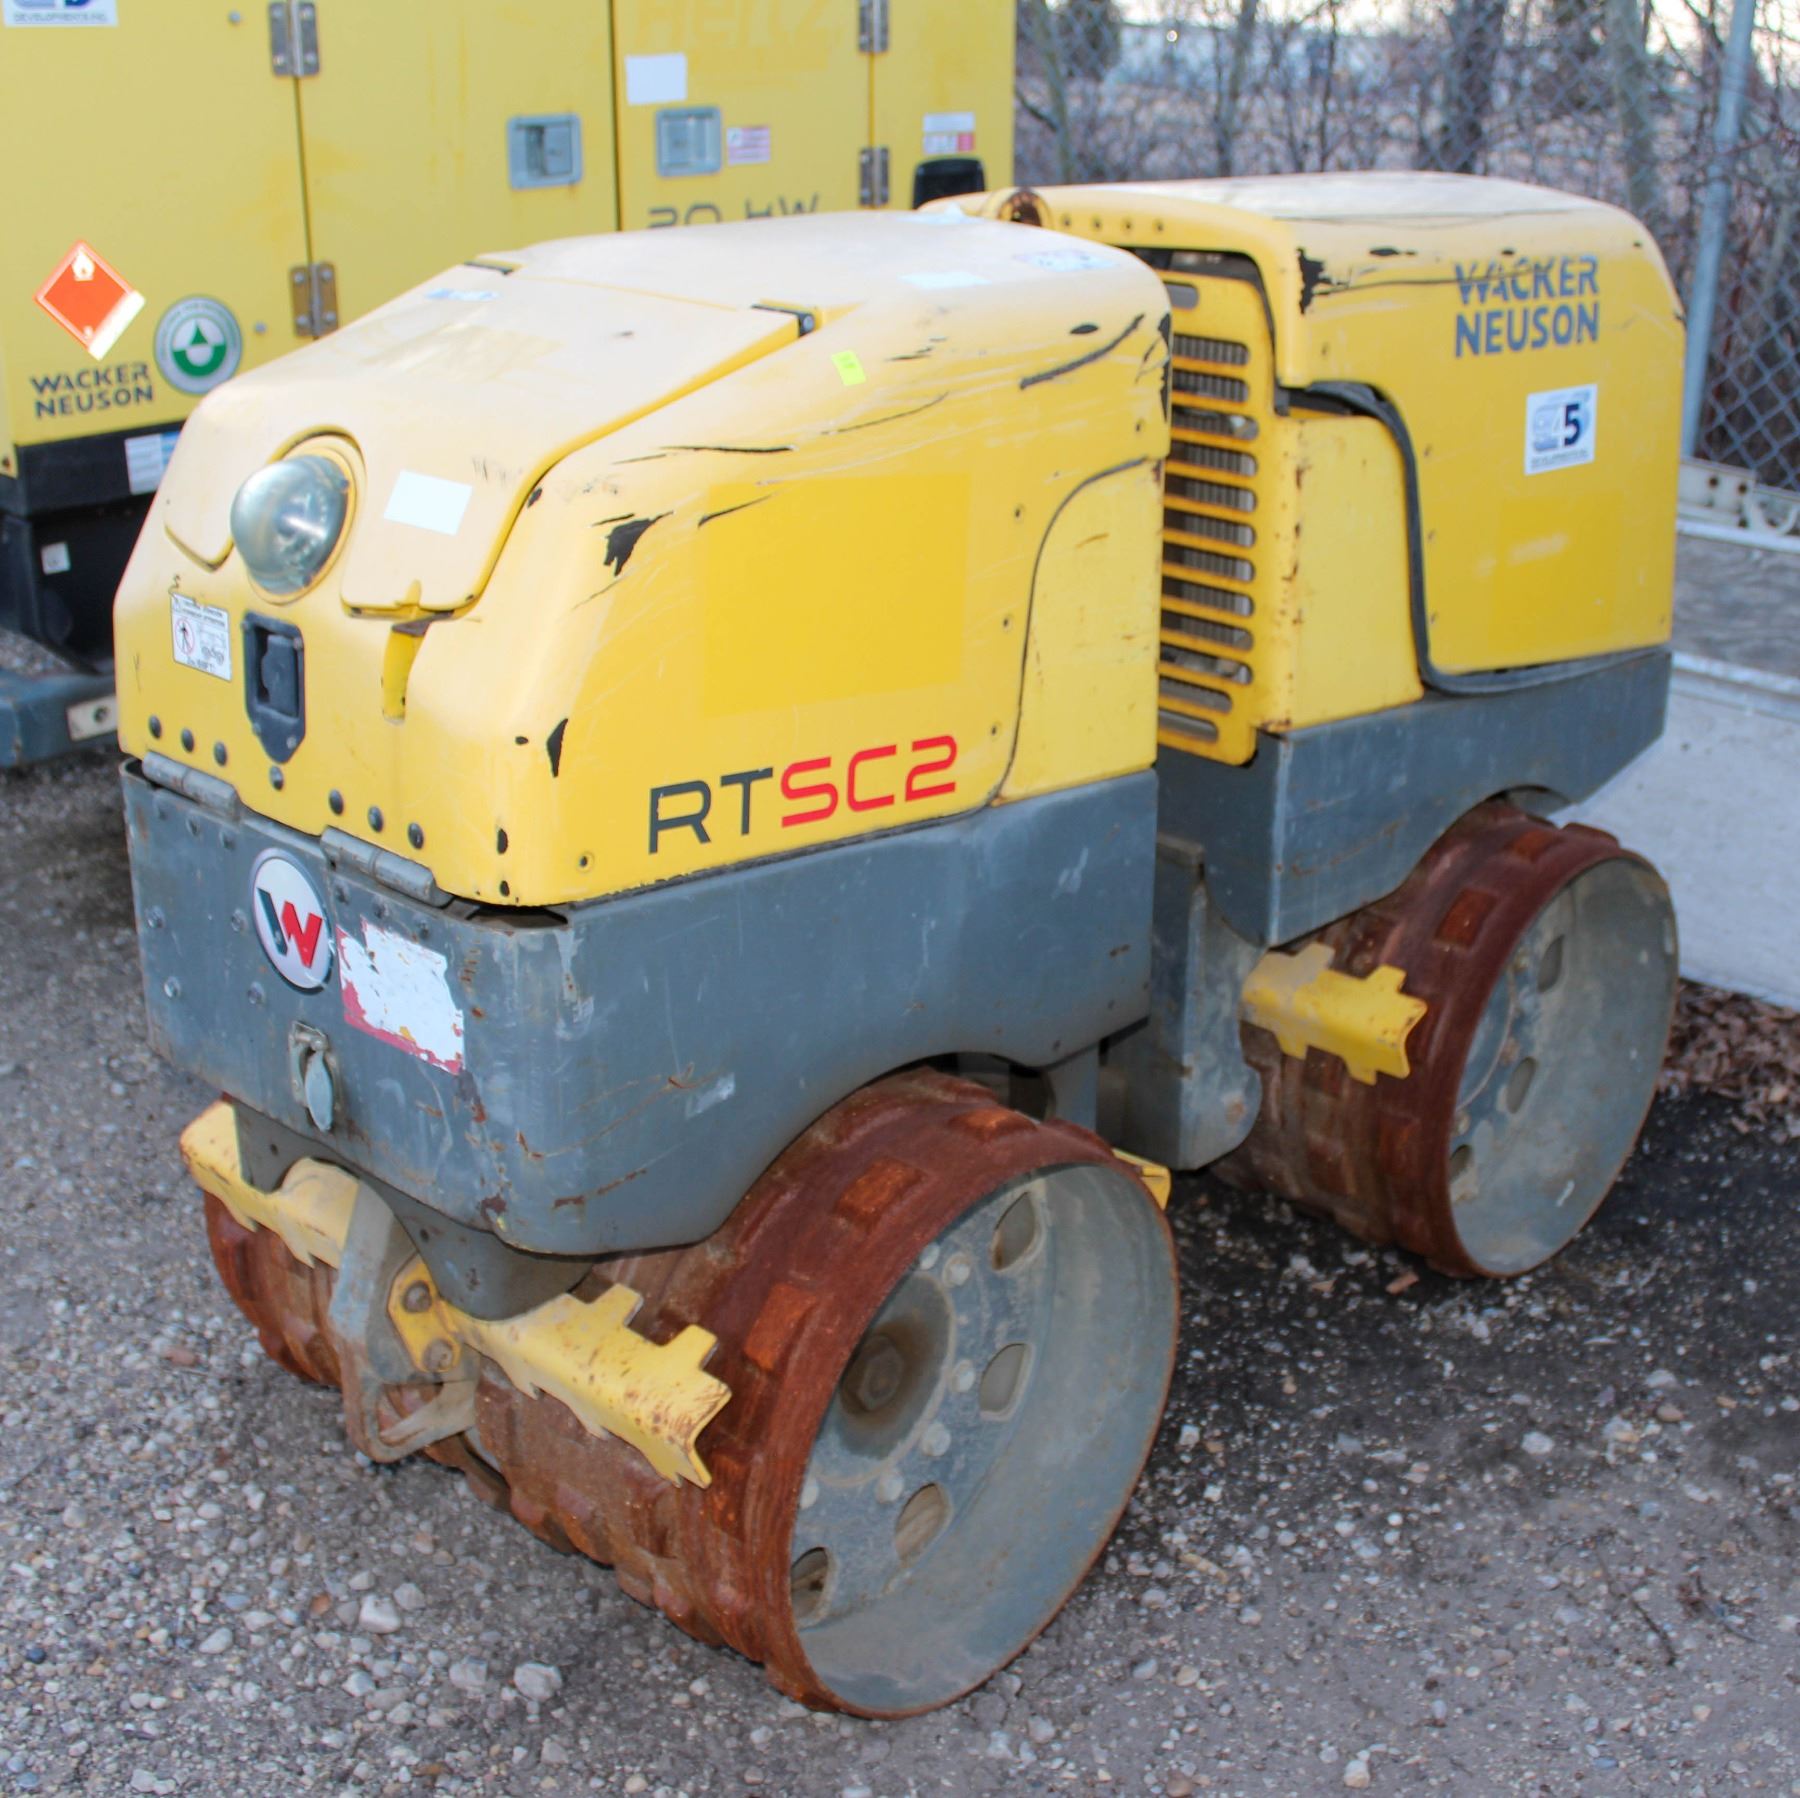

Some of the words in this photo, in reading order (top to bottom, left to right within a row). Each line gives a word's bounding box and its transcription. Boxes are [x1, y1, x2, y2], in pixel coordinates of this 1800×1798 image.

[1454, 254, 1599, 306] WACKER
[1454, 301, 1599, 358] NEUSON
[31, 361, 151, 395] WACKER
[35, 384, 154, 419] NEUSON
[647, 735, 957, 855] RTSC2
